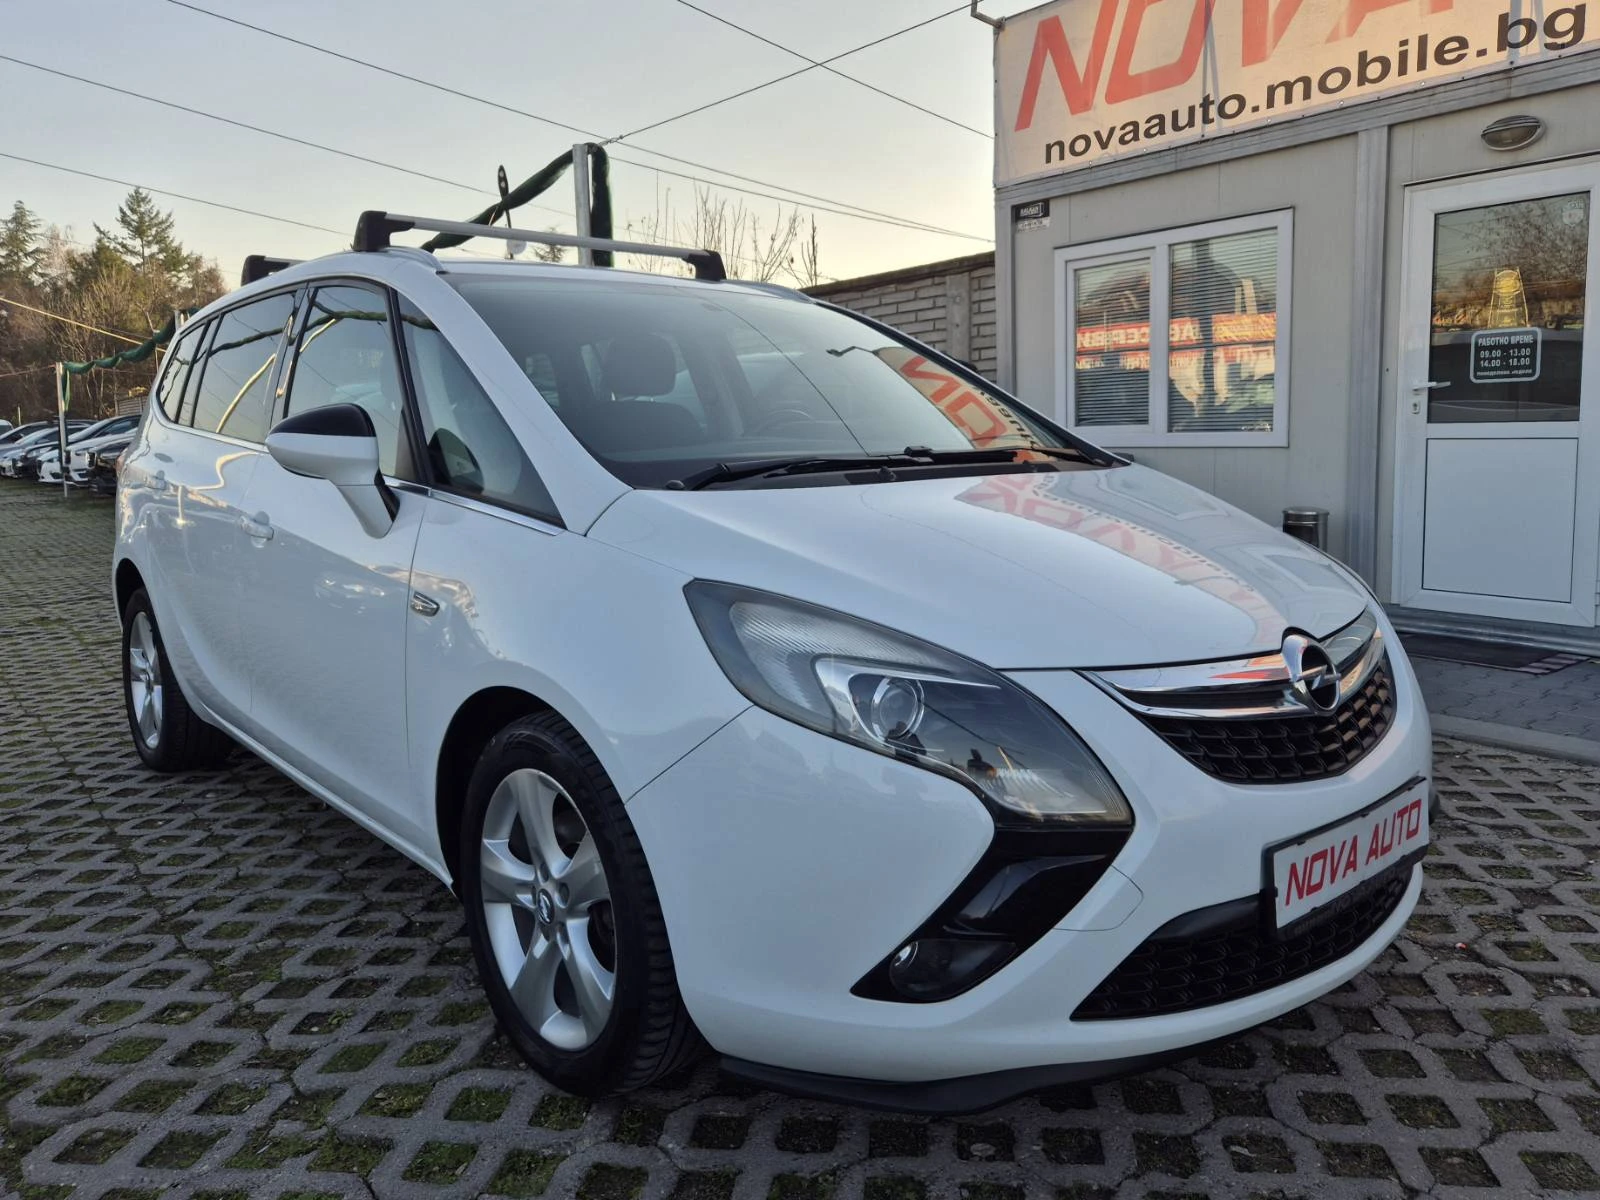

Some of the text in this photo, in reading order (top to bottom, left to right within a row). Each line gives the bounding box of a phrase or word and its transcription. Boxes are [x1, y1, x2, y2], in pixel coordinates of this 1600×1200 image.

[1014, 0, 1454, 132] NOV
[1045, 3, 1587, 164] novaauto.mobile.bg
[1479, 349, 1501, 358] 09.00
[1509, 348, 1531, 357] 13.00
[1479, 359, 1501, 368] 14.00
[1285, 798, 1422, 906] NOVA AUTO
